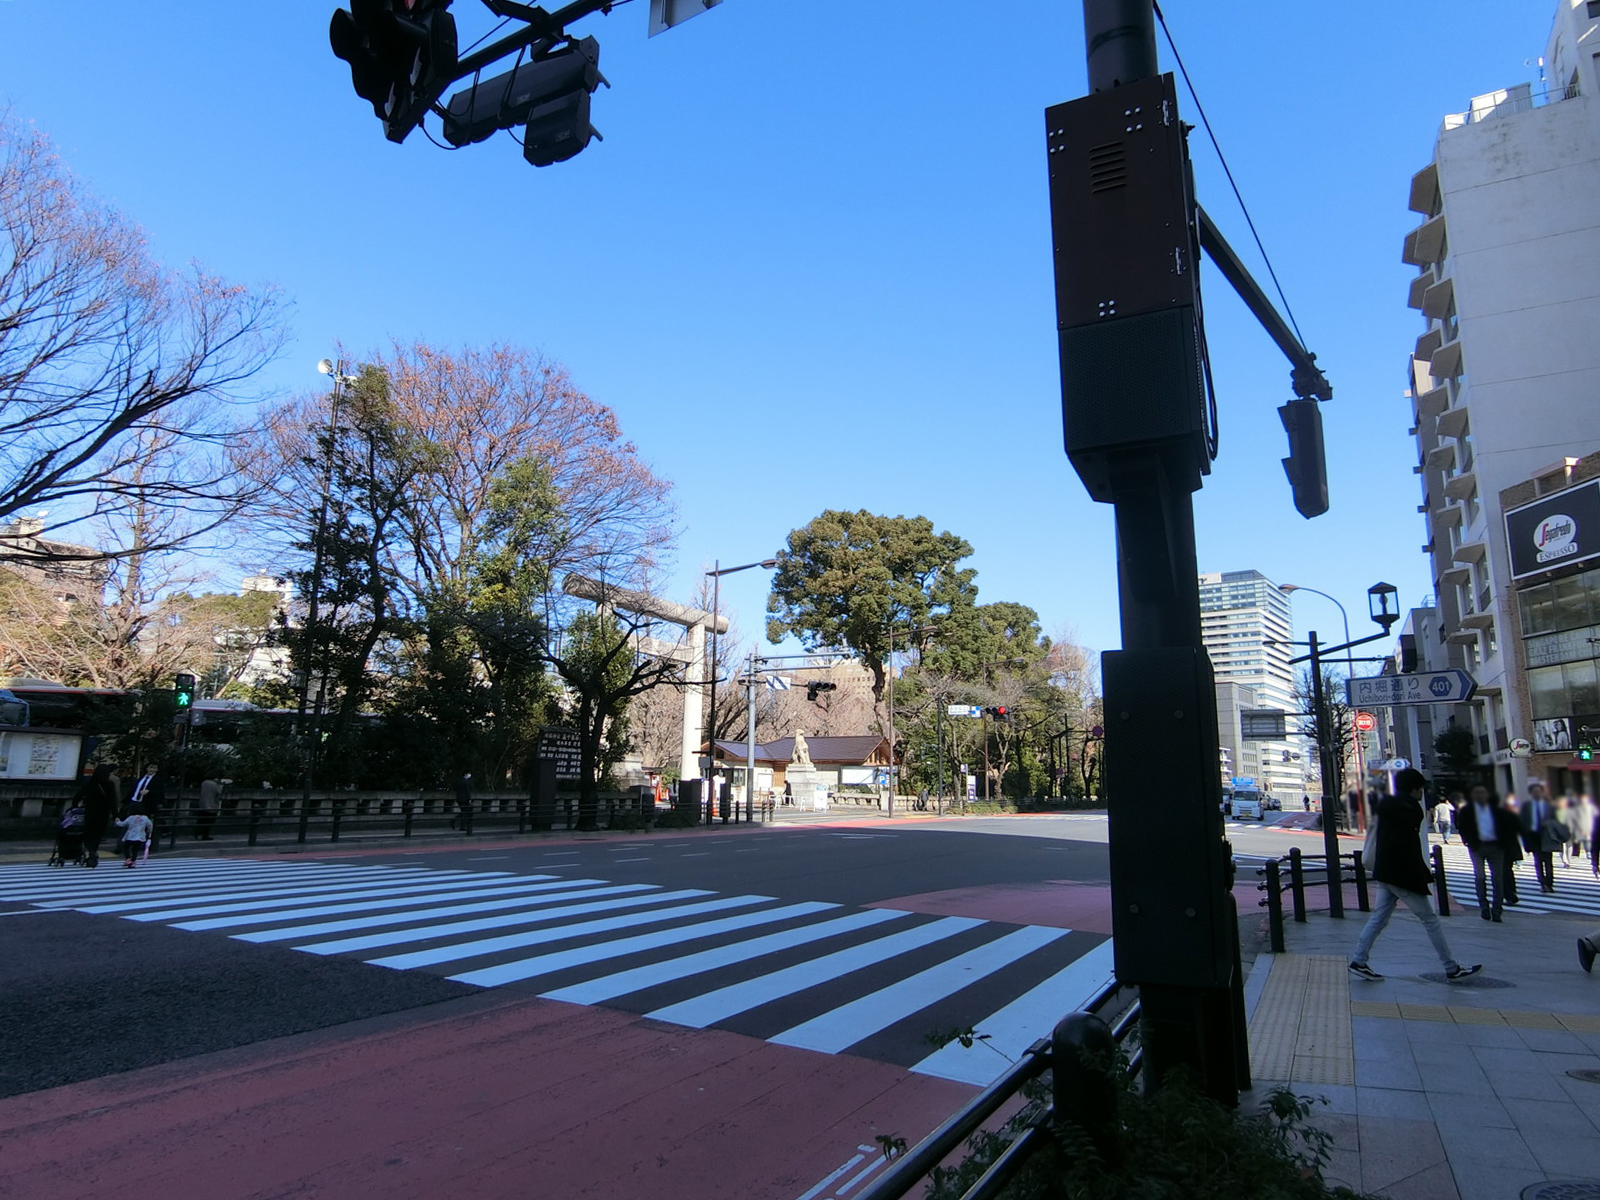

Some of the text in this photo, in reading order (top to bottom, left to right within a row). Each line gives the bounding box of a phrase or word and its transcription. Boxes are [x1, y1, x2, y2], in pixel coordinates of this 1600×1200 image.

[1539, 520, 1571, 547] Segafredo
[1540, 544, 1575, 561] ESPRESSO
[1527, 634, 1571, 648] SINGAPORE
[1359, 677, 1419, 694] 内堀通り
[1432, 681, 1450, 692] 401
[1359, 691, 1405, 704] Uchibori-dori
